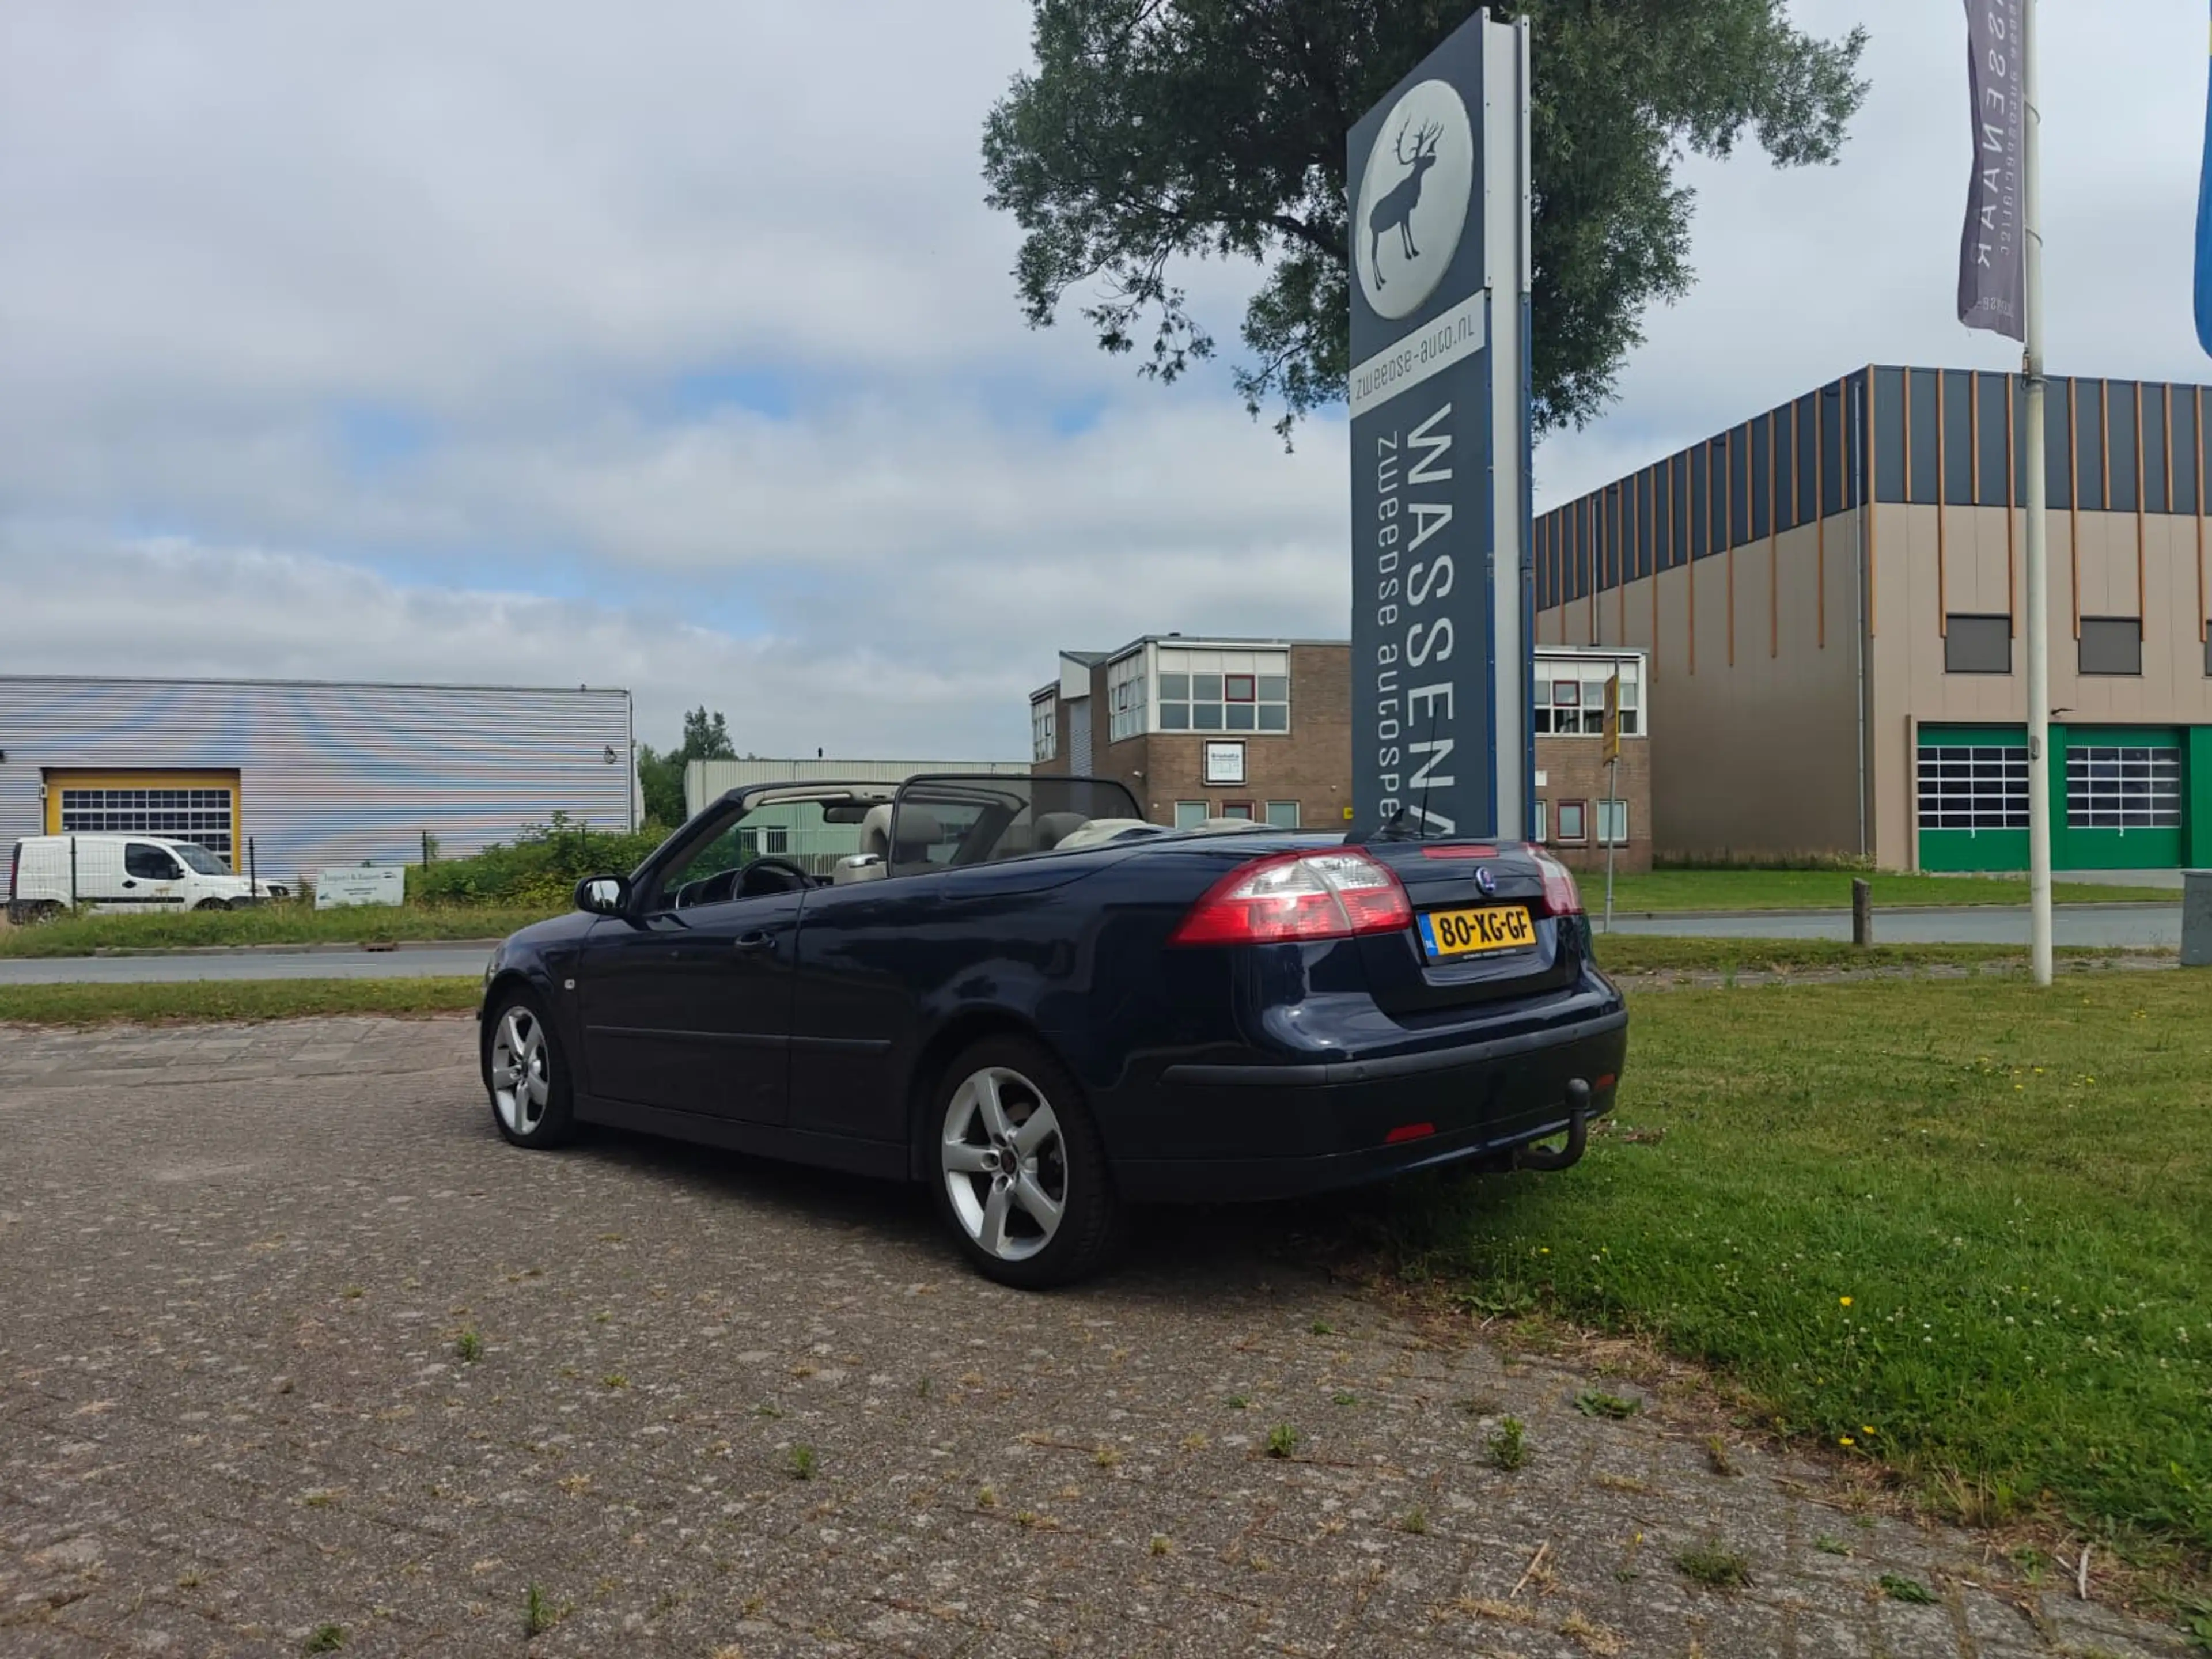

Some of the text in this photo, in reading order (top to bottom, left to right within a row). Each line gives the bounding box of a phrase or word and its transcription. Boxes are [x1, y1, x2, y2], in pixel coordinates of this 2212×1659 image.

[1378, 431, 1400, 824] zweedse autospe
[1440, 911, 1527, 946] 80-XG-GF
